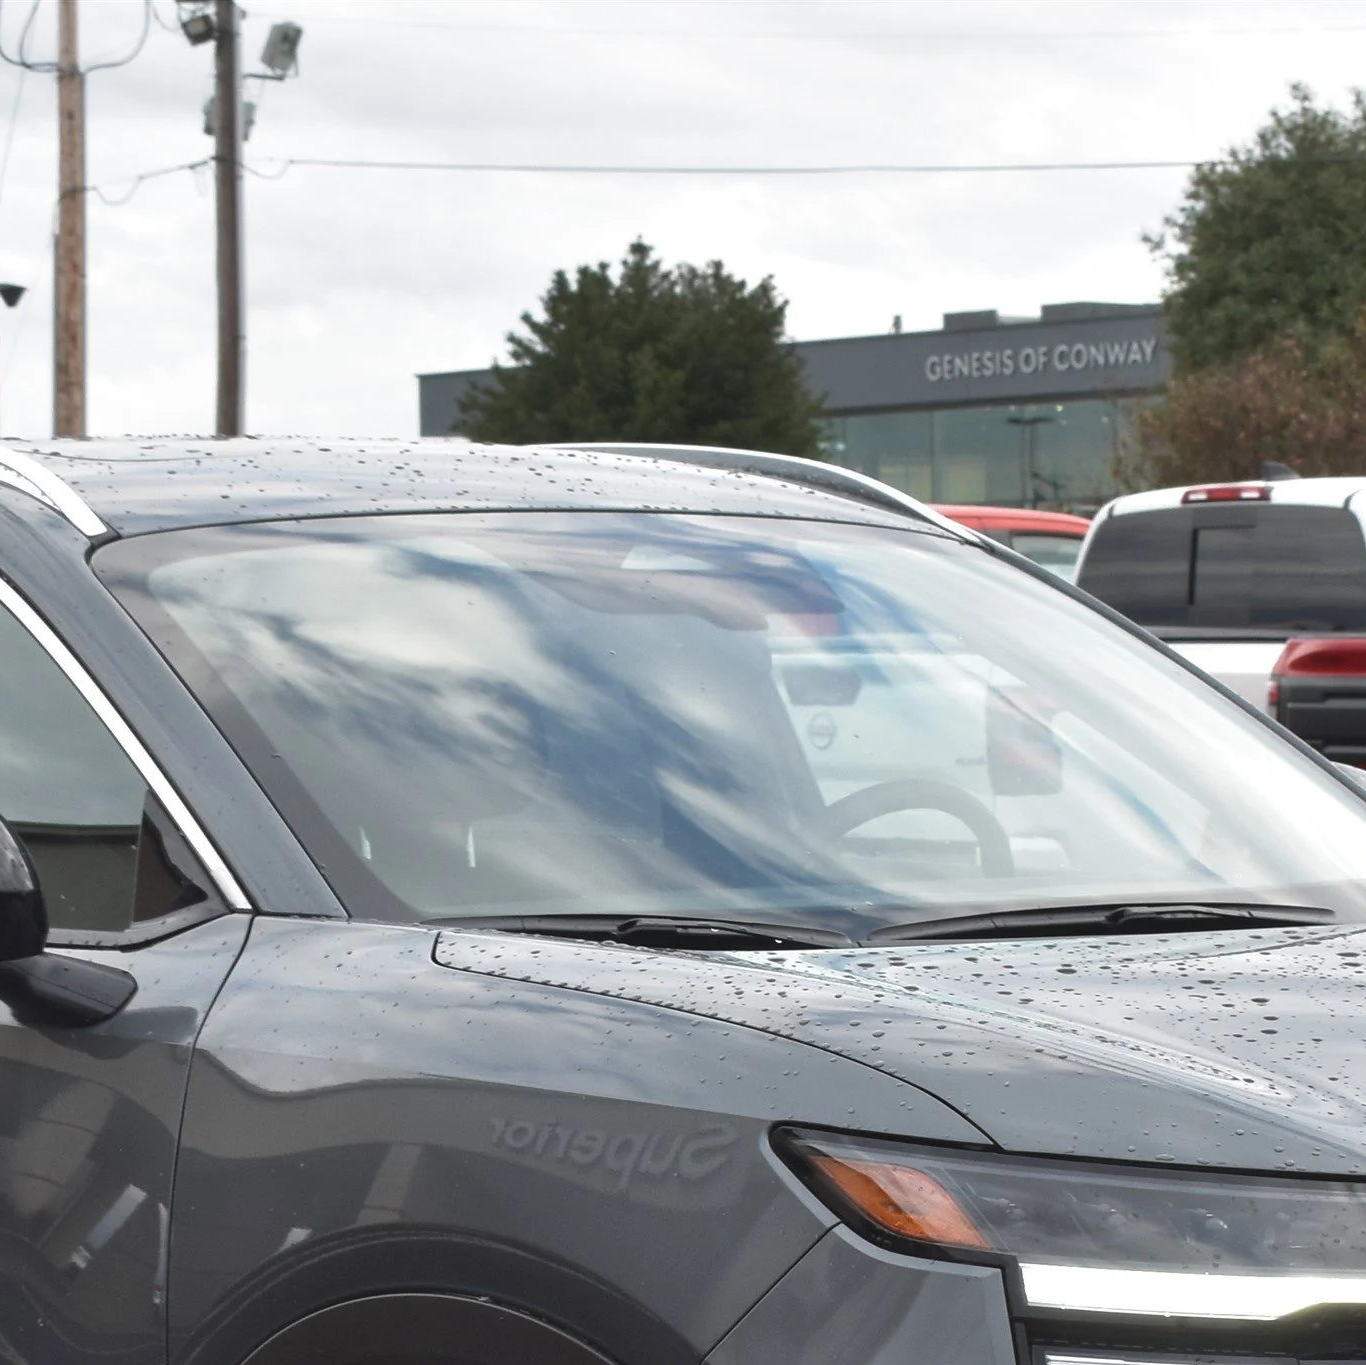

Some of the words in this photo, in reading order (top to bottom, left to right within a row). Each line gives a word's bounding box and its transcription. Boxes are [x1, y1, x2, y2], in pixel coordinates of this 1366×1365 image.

[925, 349, 1014, 382] GENESIS
[1019, 346, 1048, 374] OF
[1053, 338, 1157, 371] CONWAY
